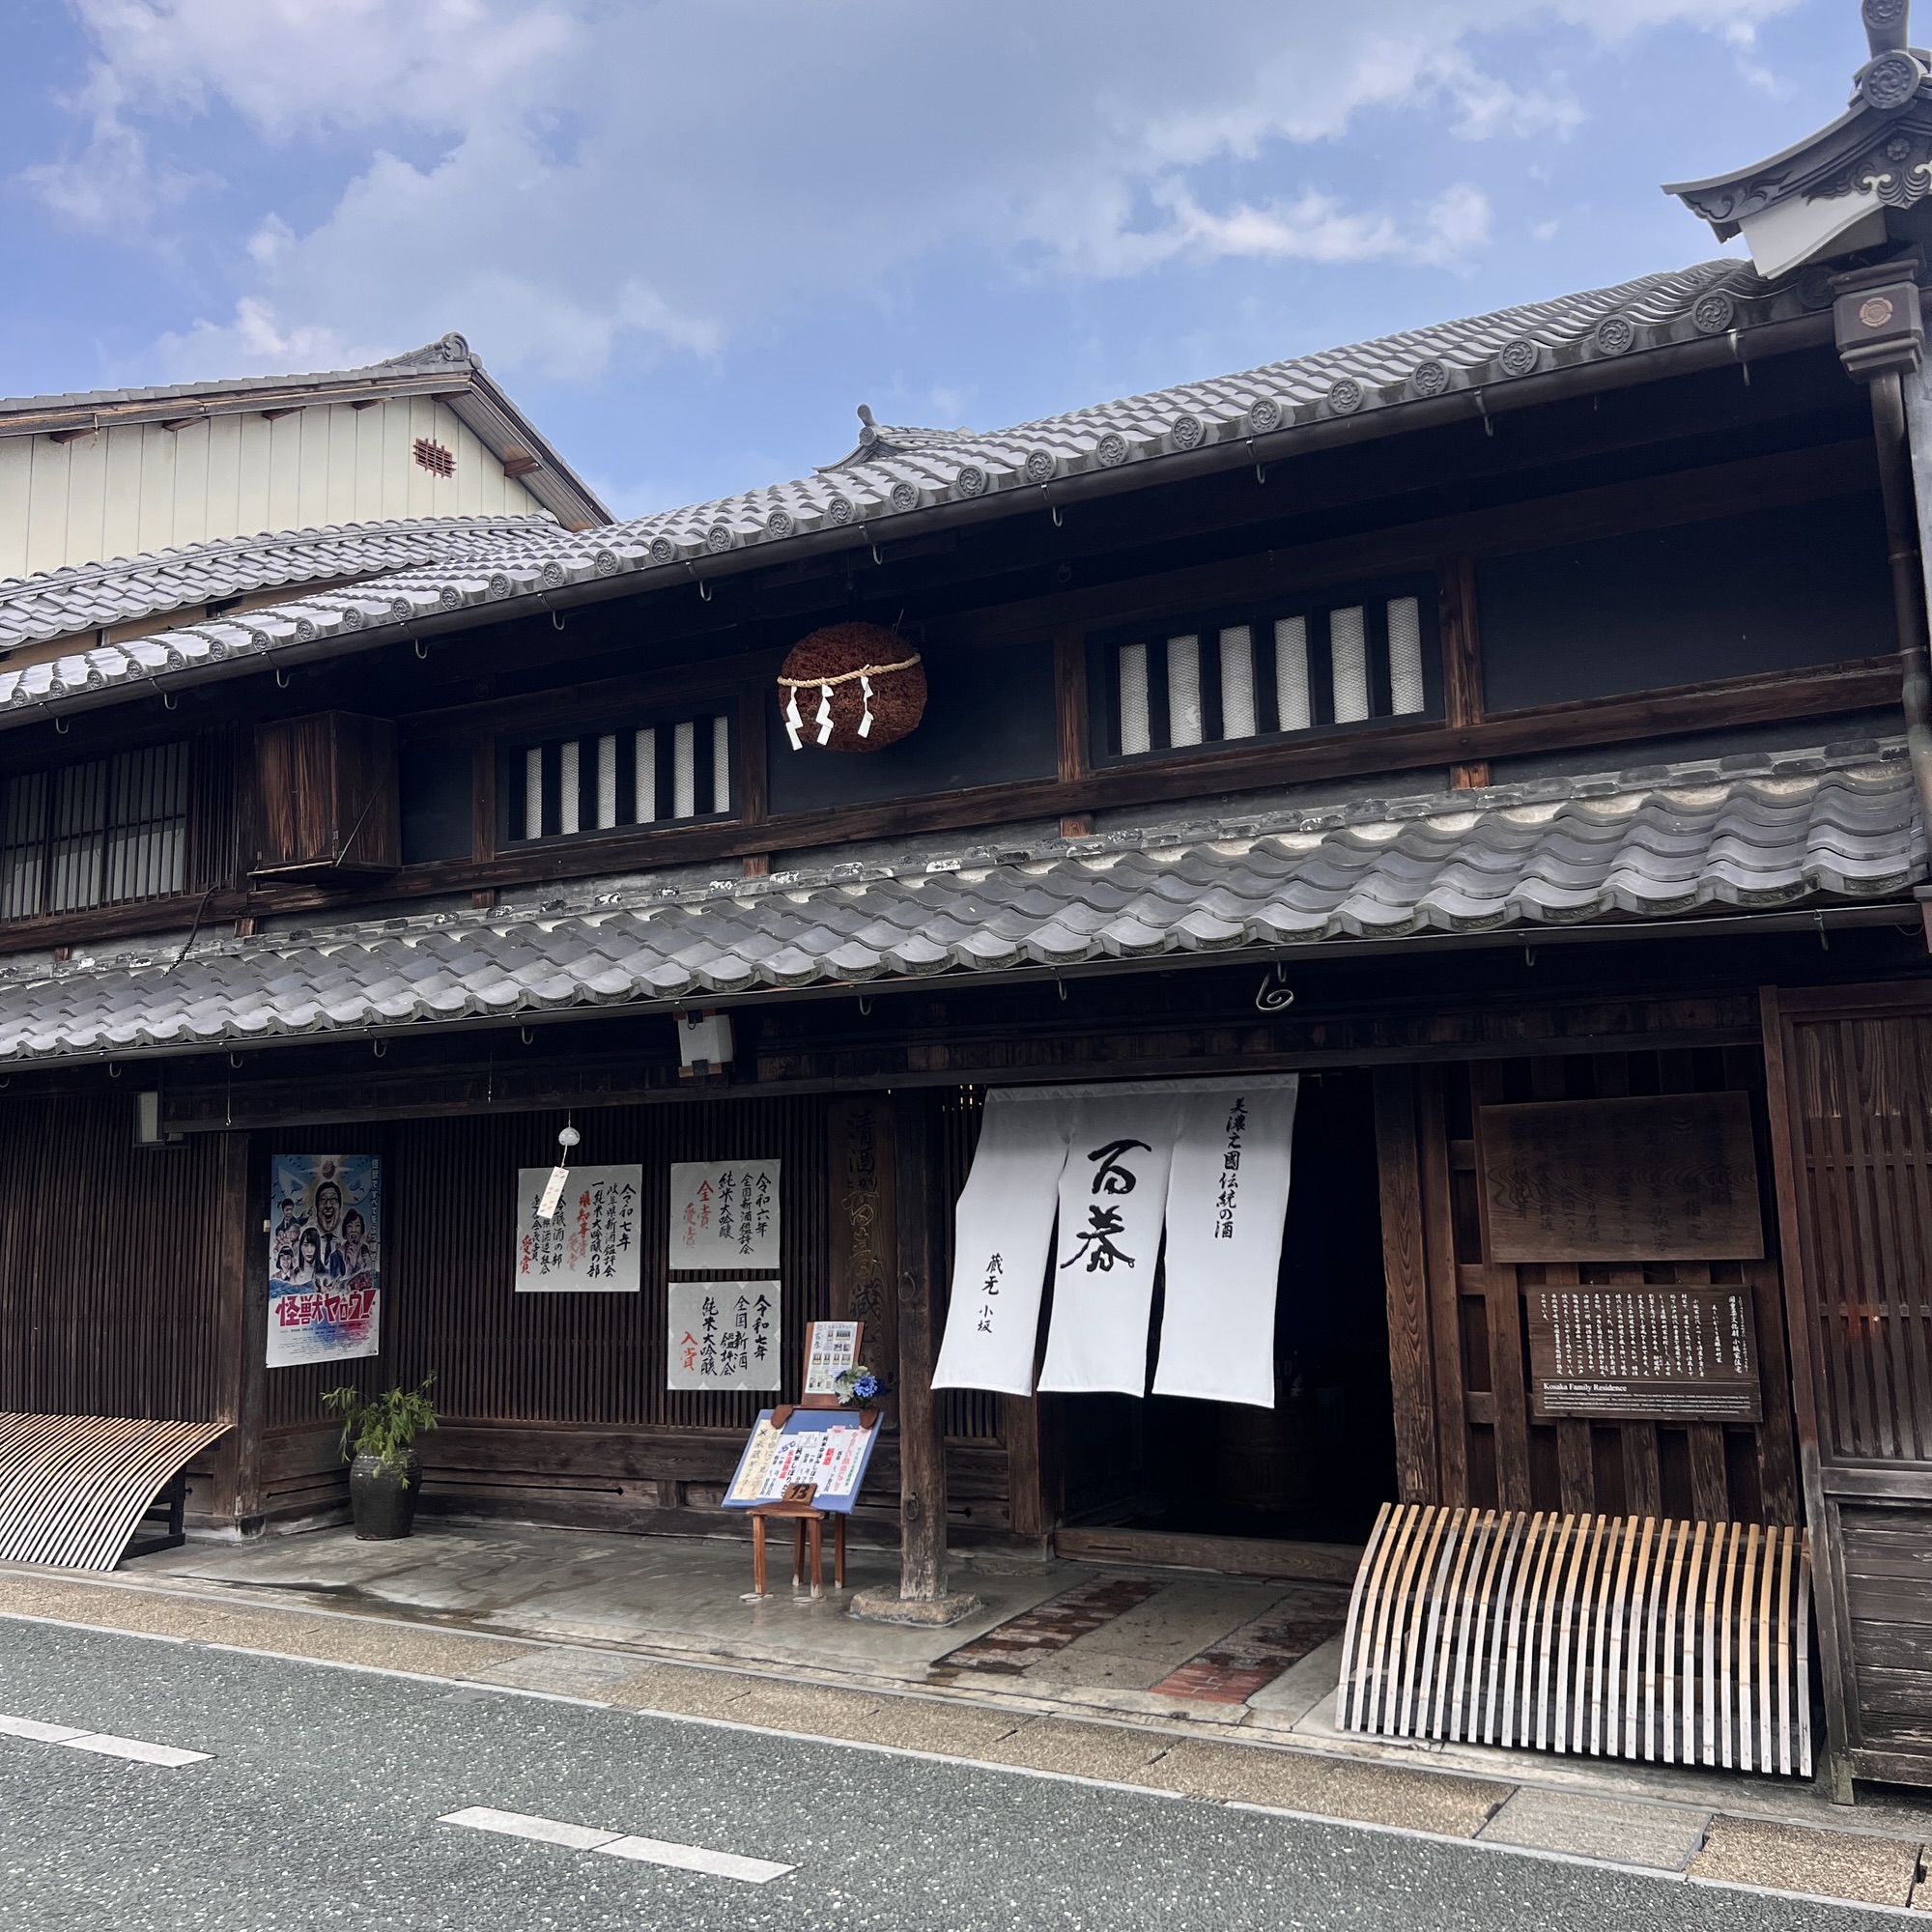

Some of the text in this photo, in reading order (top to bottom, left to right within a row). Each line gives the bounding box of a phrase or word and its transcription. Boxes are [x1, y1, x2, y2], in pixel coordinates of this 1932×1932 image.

[1214, 1096, 1248, 1239] 美濃之國伝統の酒
[552, 1188, 568, 1270] 吟醸酒の部
[616, 1182, 638, 1253] 令和七年
[696, 1179, 715, 1231] 金賞
[718, 1170, 737, 1240] 純米大吟醸
[754, 1171, 772, 1239] 令和六年
[751, 1293, 772, 1362] 令和七年
[978, 1253, 1004, 1334] 蔵元 小坂
[680, 1330, 698, 1372] 入賞
[699, 1295, 720, 1378] 純米大吟醸
[1544, 1382, 1628, 1392] Kosaka Family Residence
